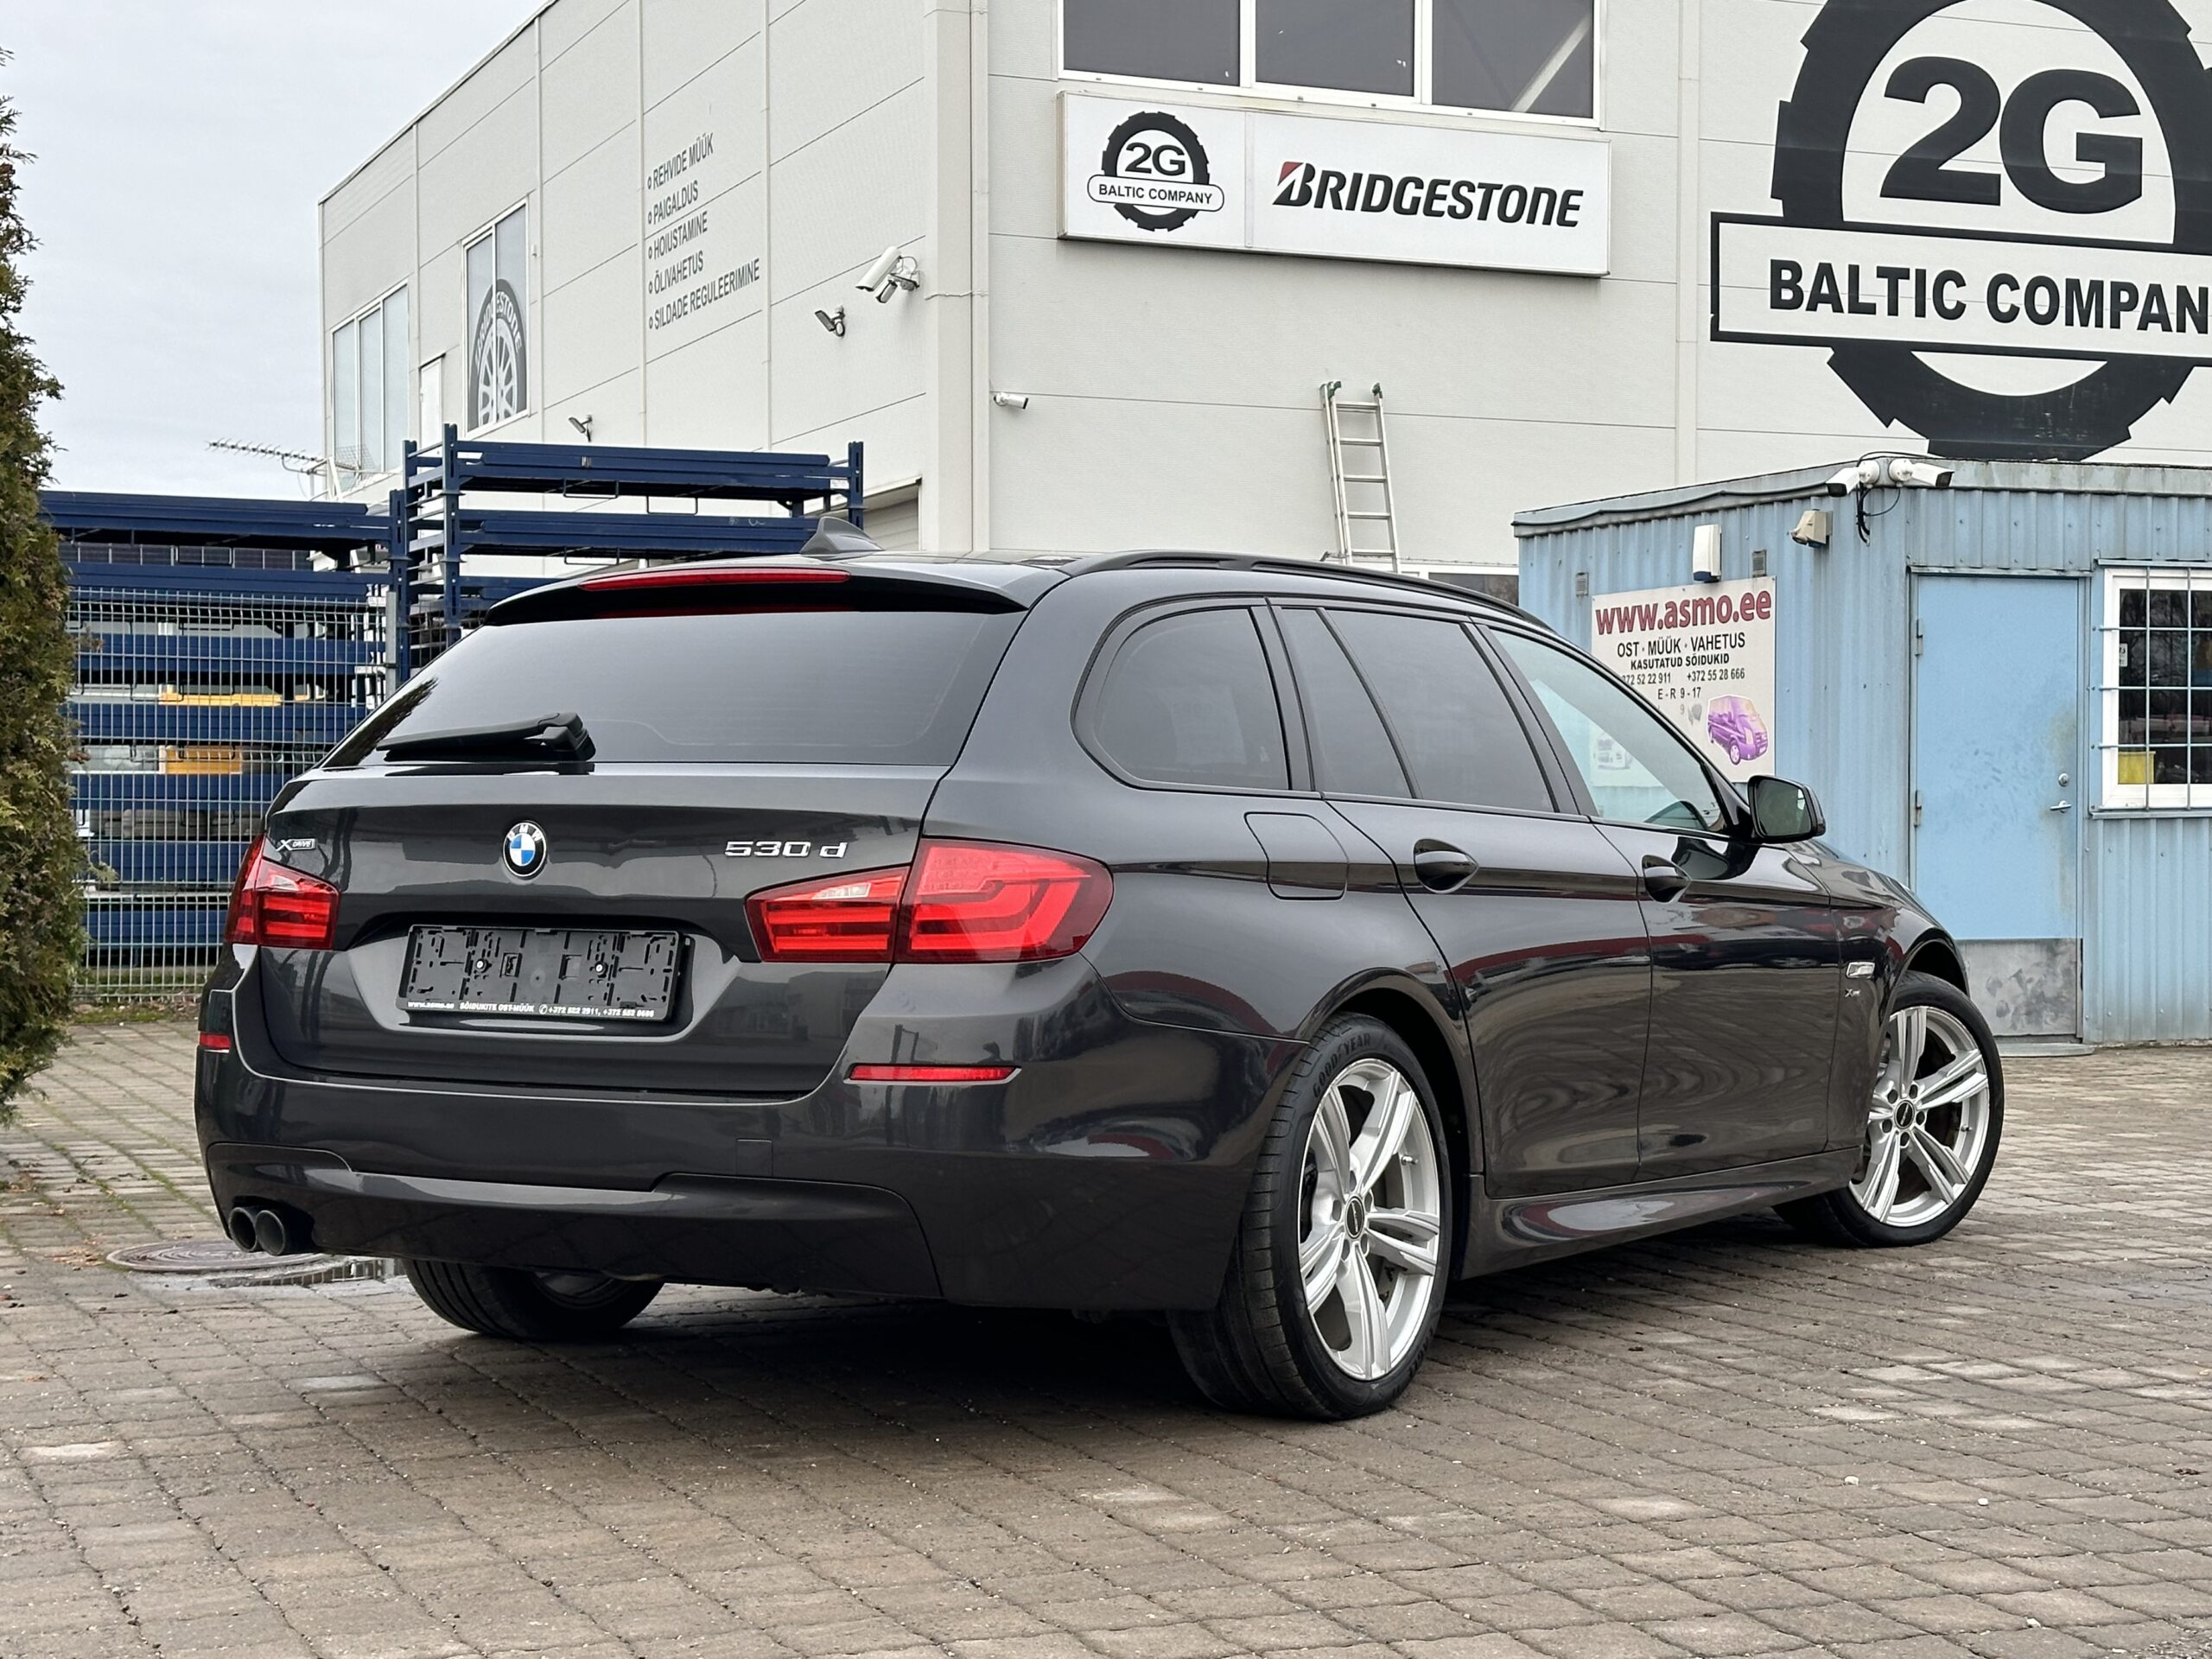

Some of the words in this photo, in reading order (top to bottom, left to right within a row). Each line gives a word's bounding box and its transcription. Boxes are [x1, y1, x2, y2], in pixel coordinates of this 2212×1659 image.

[1879, 55, 2143, 214] 2G
[653, 149, 688, 190] REHVIDE
[689, 132, 714, 168] MÜÜK
[1125, 142, 1185, 176] 2G
[653, 180, 699, 225] PAIGALDUS
[1098, 183, 1145, 199] BALTIC
[1148, 188, 1212, 205] COMPANY
[1272, 161, 1585, 228] BRIDGESTONE
[653, 211, 709, 259] HOIUSTAMINE
[654, 250, 704, 295] ÕLIVAHETUS
[654, 295, 689, 330] SILDADE
[690, 258, 760, 313] REGULEERIMINE
[1770, 258, 1967, 321] BALTIC
[1986, 273, 2209, 334] COMPAN
[1596, 590, 1771, 635] www.asmo.ee
[1617, 641, 1639, 658] OST
[1648, 635, 1681, 656] MÜÜK
[1691, 632, 1745, 652] VAHETUS
[1630, 657, 1682, 670] KASUTATUD
[1685, 653, 1729, 666] SÕIDUKID
[1637, 674, 1646, 685] 52
[1648, 673, 1656, 684] 22
[1658, 672, 1671, 683] 911
[1687, 670, 1706, 682] +372
[1707, 669, 1717, 681] 55
[1719, 669, 1728, 680] 28
[1731, 668, 1745, 679] 666
[506, 823, 543, 842] BMW
[725, 841, 811, 856] 530
[819, 842, 848, 858] d
